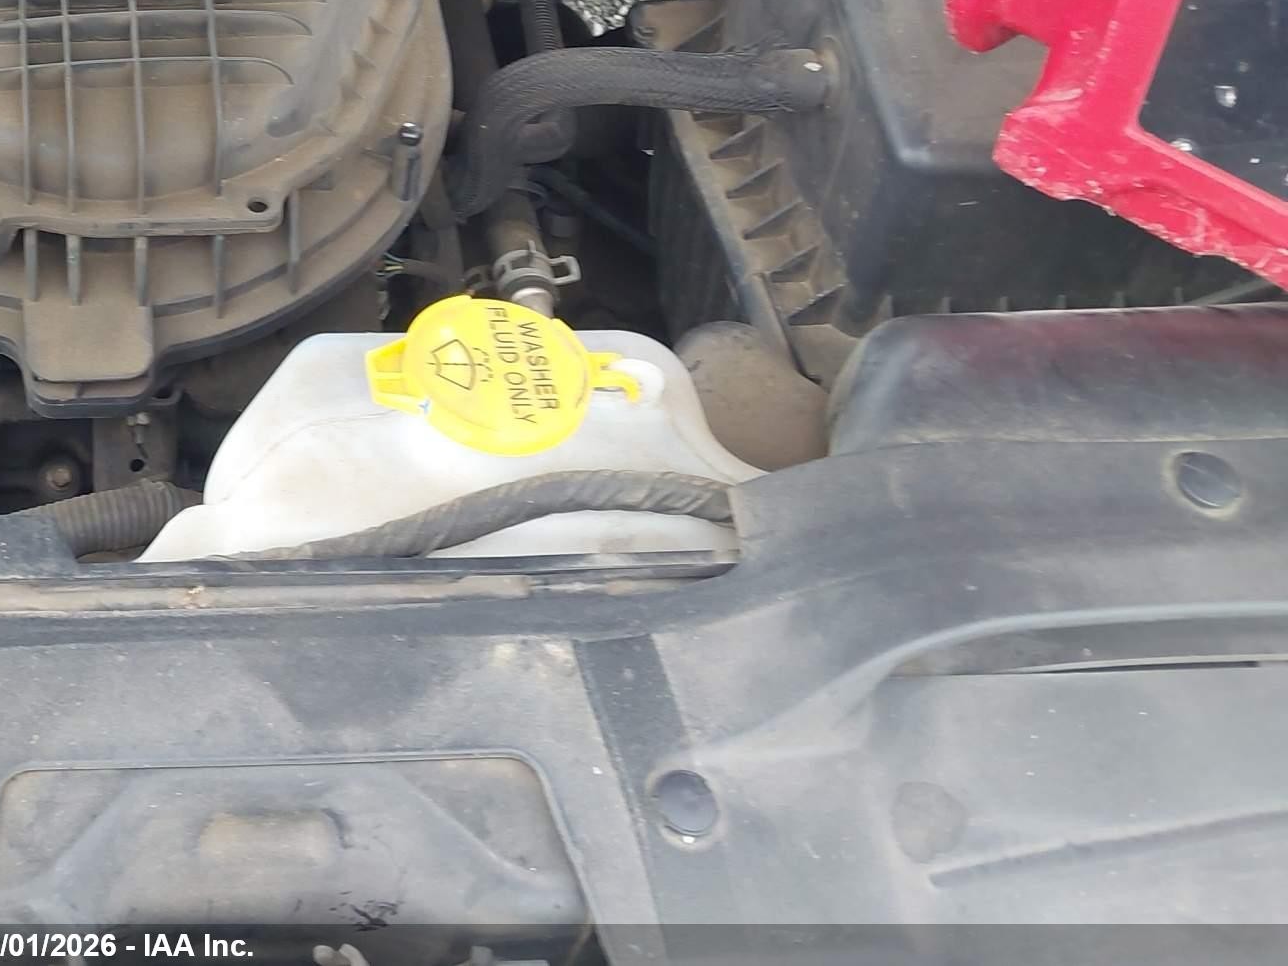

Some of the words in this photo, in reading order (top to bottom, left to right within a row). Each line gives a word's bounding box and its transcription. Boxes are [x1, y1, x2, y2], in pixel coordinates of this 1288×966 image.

[486, 306, 520, 365] FLUID
[503, 371, 539, 425] ONLY
[517, 320, 561, 411] WASHER
